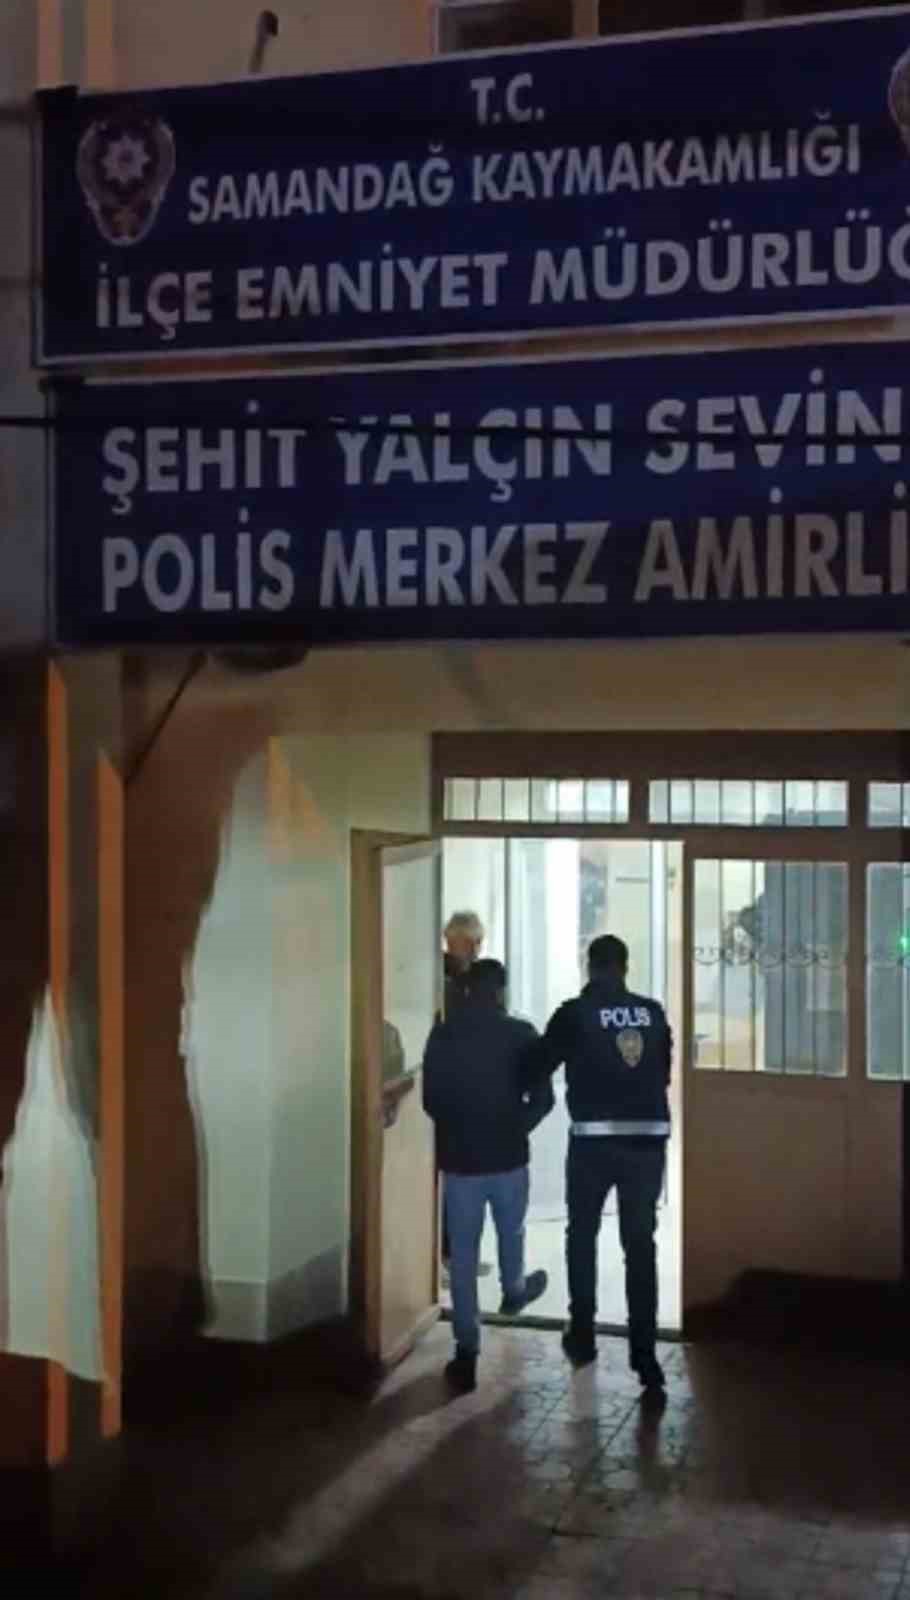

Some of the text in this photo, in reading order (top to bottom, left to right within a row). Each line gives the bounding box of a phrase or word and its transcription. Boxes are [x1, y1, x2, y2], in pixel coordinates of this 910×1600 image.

[471, 73, 545, 125] T.C.
[188, 111, 861, 225] SAMANDAĞ KAYMAKAMLIĞI
[96, 263, 213, 340] İLÇE
[237, 243, 508, 320] EMNİYET
[103, 368, 902, 515] ŞEHİT YALÇIN SEVİN
[103, 481, 908, 612] POLİS MERKEZ AMİRLİ
